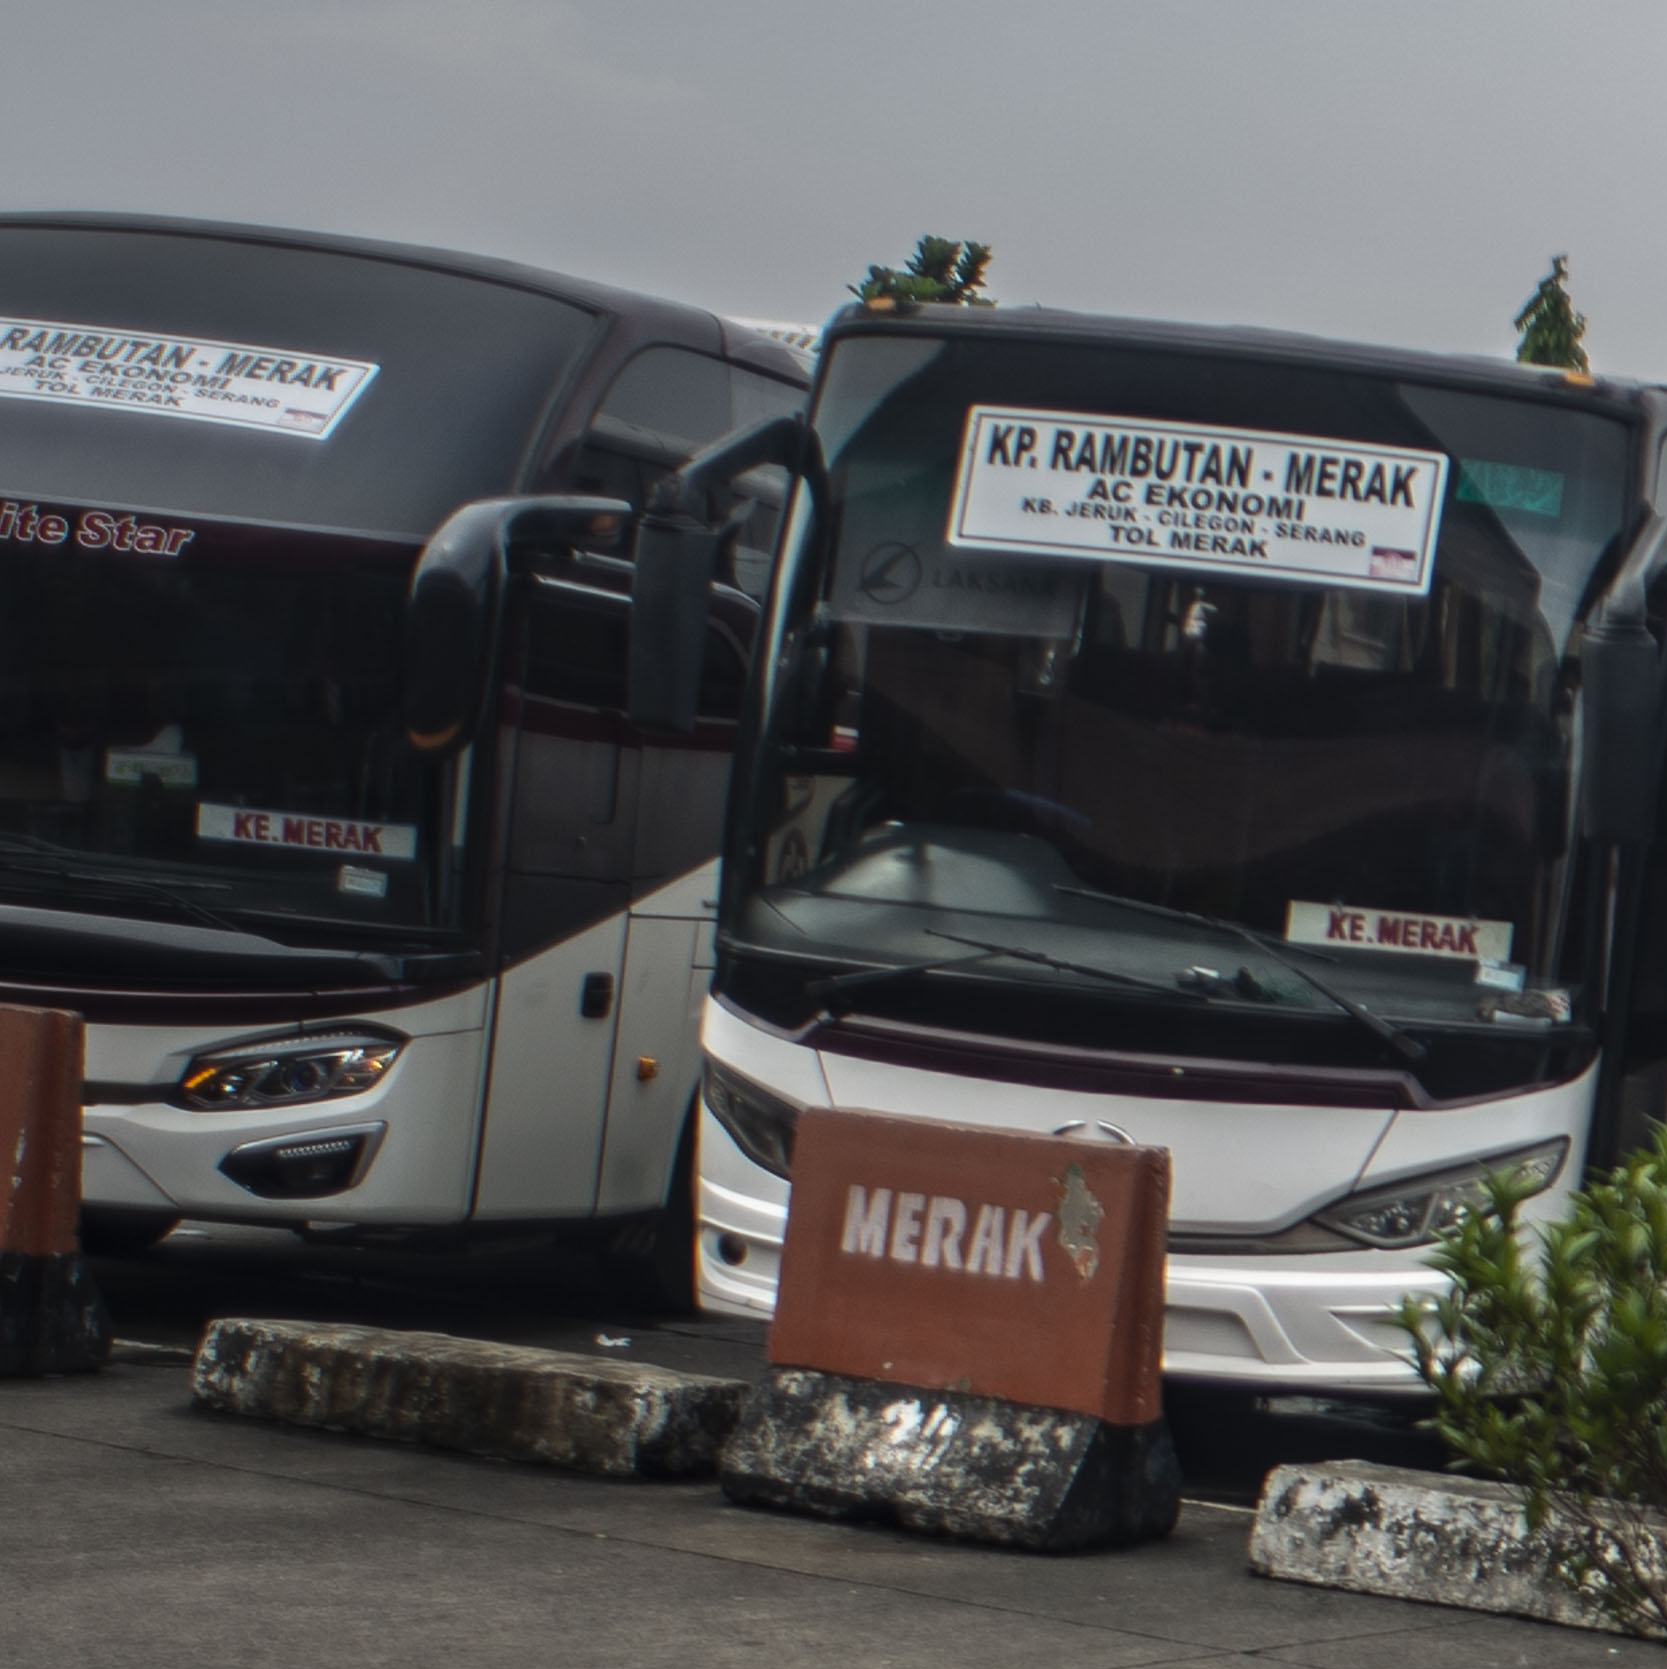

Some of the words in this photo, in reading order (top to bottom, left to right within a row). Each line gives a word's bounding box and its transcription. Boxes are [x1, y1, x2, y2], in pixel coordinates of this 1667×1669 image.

[0, 328, 197, 369] RAMBUTAN
[216, 352, 347, 391] MERAK
[25, 355, 71, 370] AC
[79, 360, 232, 389] EKONOMI
[36, 380, 81, 395] TOL
[90, 386, 184, 406] MERAK
[86, 375, 178, 394] CILEGON
[194, 389, 281, 409] SERANG
[987, 424, 1038, 468] KP.
[1050, 429, 1254, 488] RAMBUTAN
[1284, 454, 1417, 508] MERAK
[1089, 478, 1133, 503] AC
[1144, 483, 1306, 521] EKONOMI
[77, 511, 195, 556] Star
[1022, 498, 1059, 516] KB.
[1065, 502, 1136, 523] JERUK
[1158, 511, 1256, 535] CILEGON
[1275, 523, 1366, 548] SERANG
[1109, 525, 1160, 546] TOL
[1170, 533, 1268, 558] MERAK
[840, 1184, 1054, 1283] MERAK
